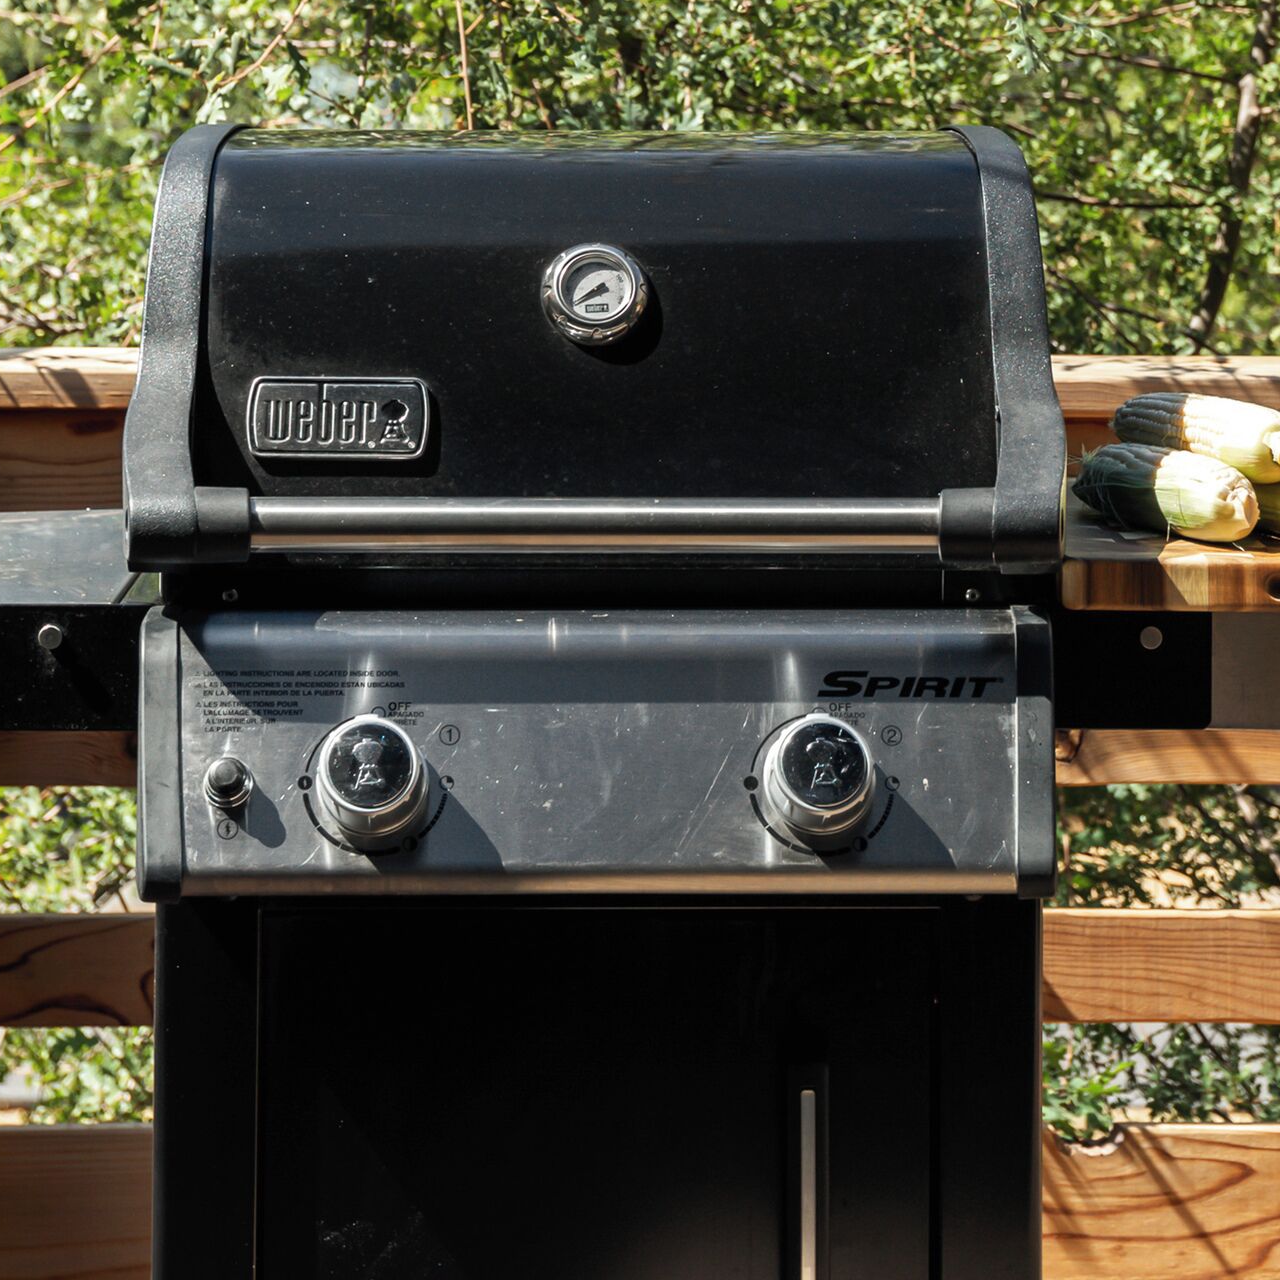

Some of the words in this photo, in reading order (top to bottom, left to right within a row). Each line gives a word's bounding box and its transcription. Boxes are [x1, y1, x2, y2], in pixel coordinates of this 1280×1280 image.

[817, 671, 998, 698] SPIRIT
[388, 702, 412, 711] OFF
[829, 702, 852, 712] OFF
